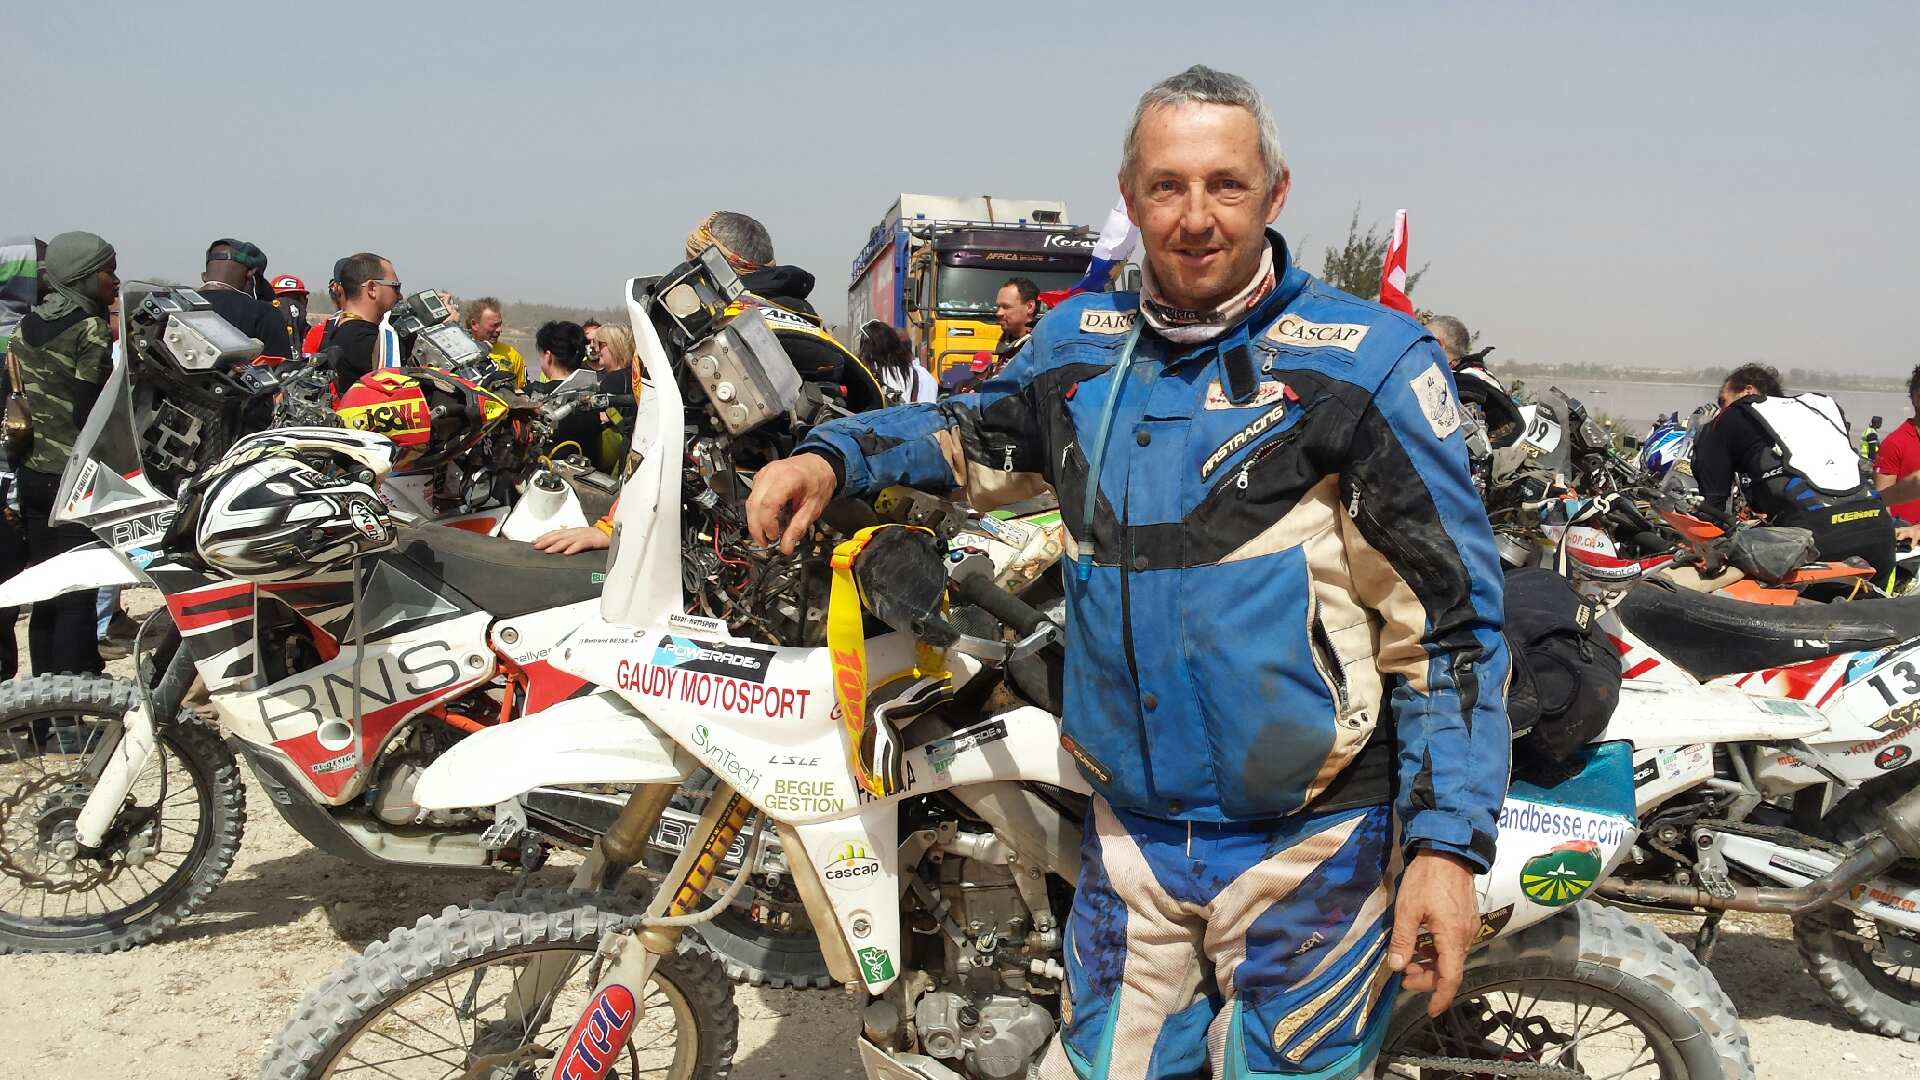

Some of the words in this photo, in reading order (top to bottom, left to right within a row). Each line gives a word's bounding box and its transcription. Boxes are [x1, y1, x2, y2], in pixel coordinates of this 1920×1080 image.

[1279, 319, 1359, 341] CASCAP
[1831, 509, 1881, 525] KENNY
[663, 643, 760, 670] POWERADE
[617, 659, 678, 700] GAUDY
[680, 671, 811, 720] MOTOSPORT
[691, 724, 763, 790] SynTech
[774, 779, 834, 796] BEGUE
[764, 795, 844, 813] GESTION
[825, 862, 879, 880] cascap
